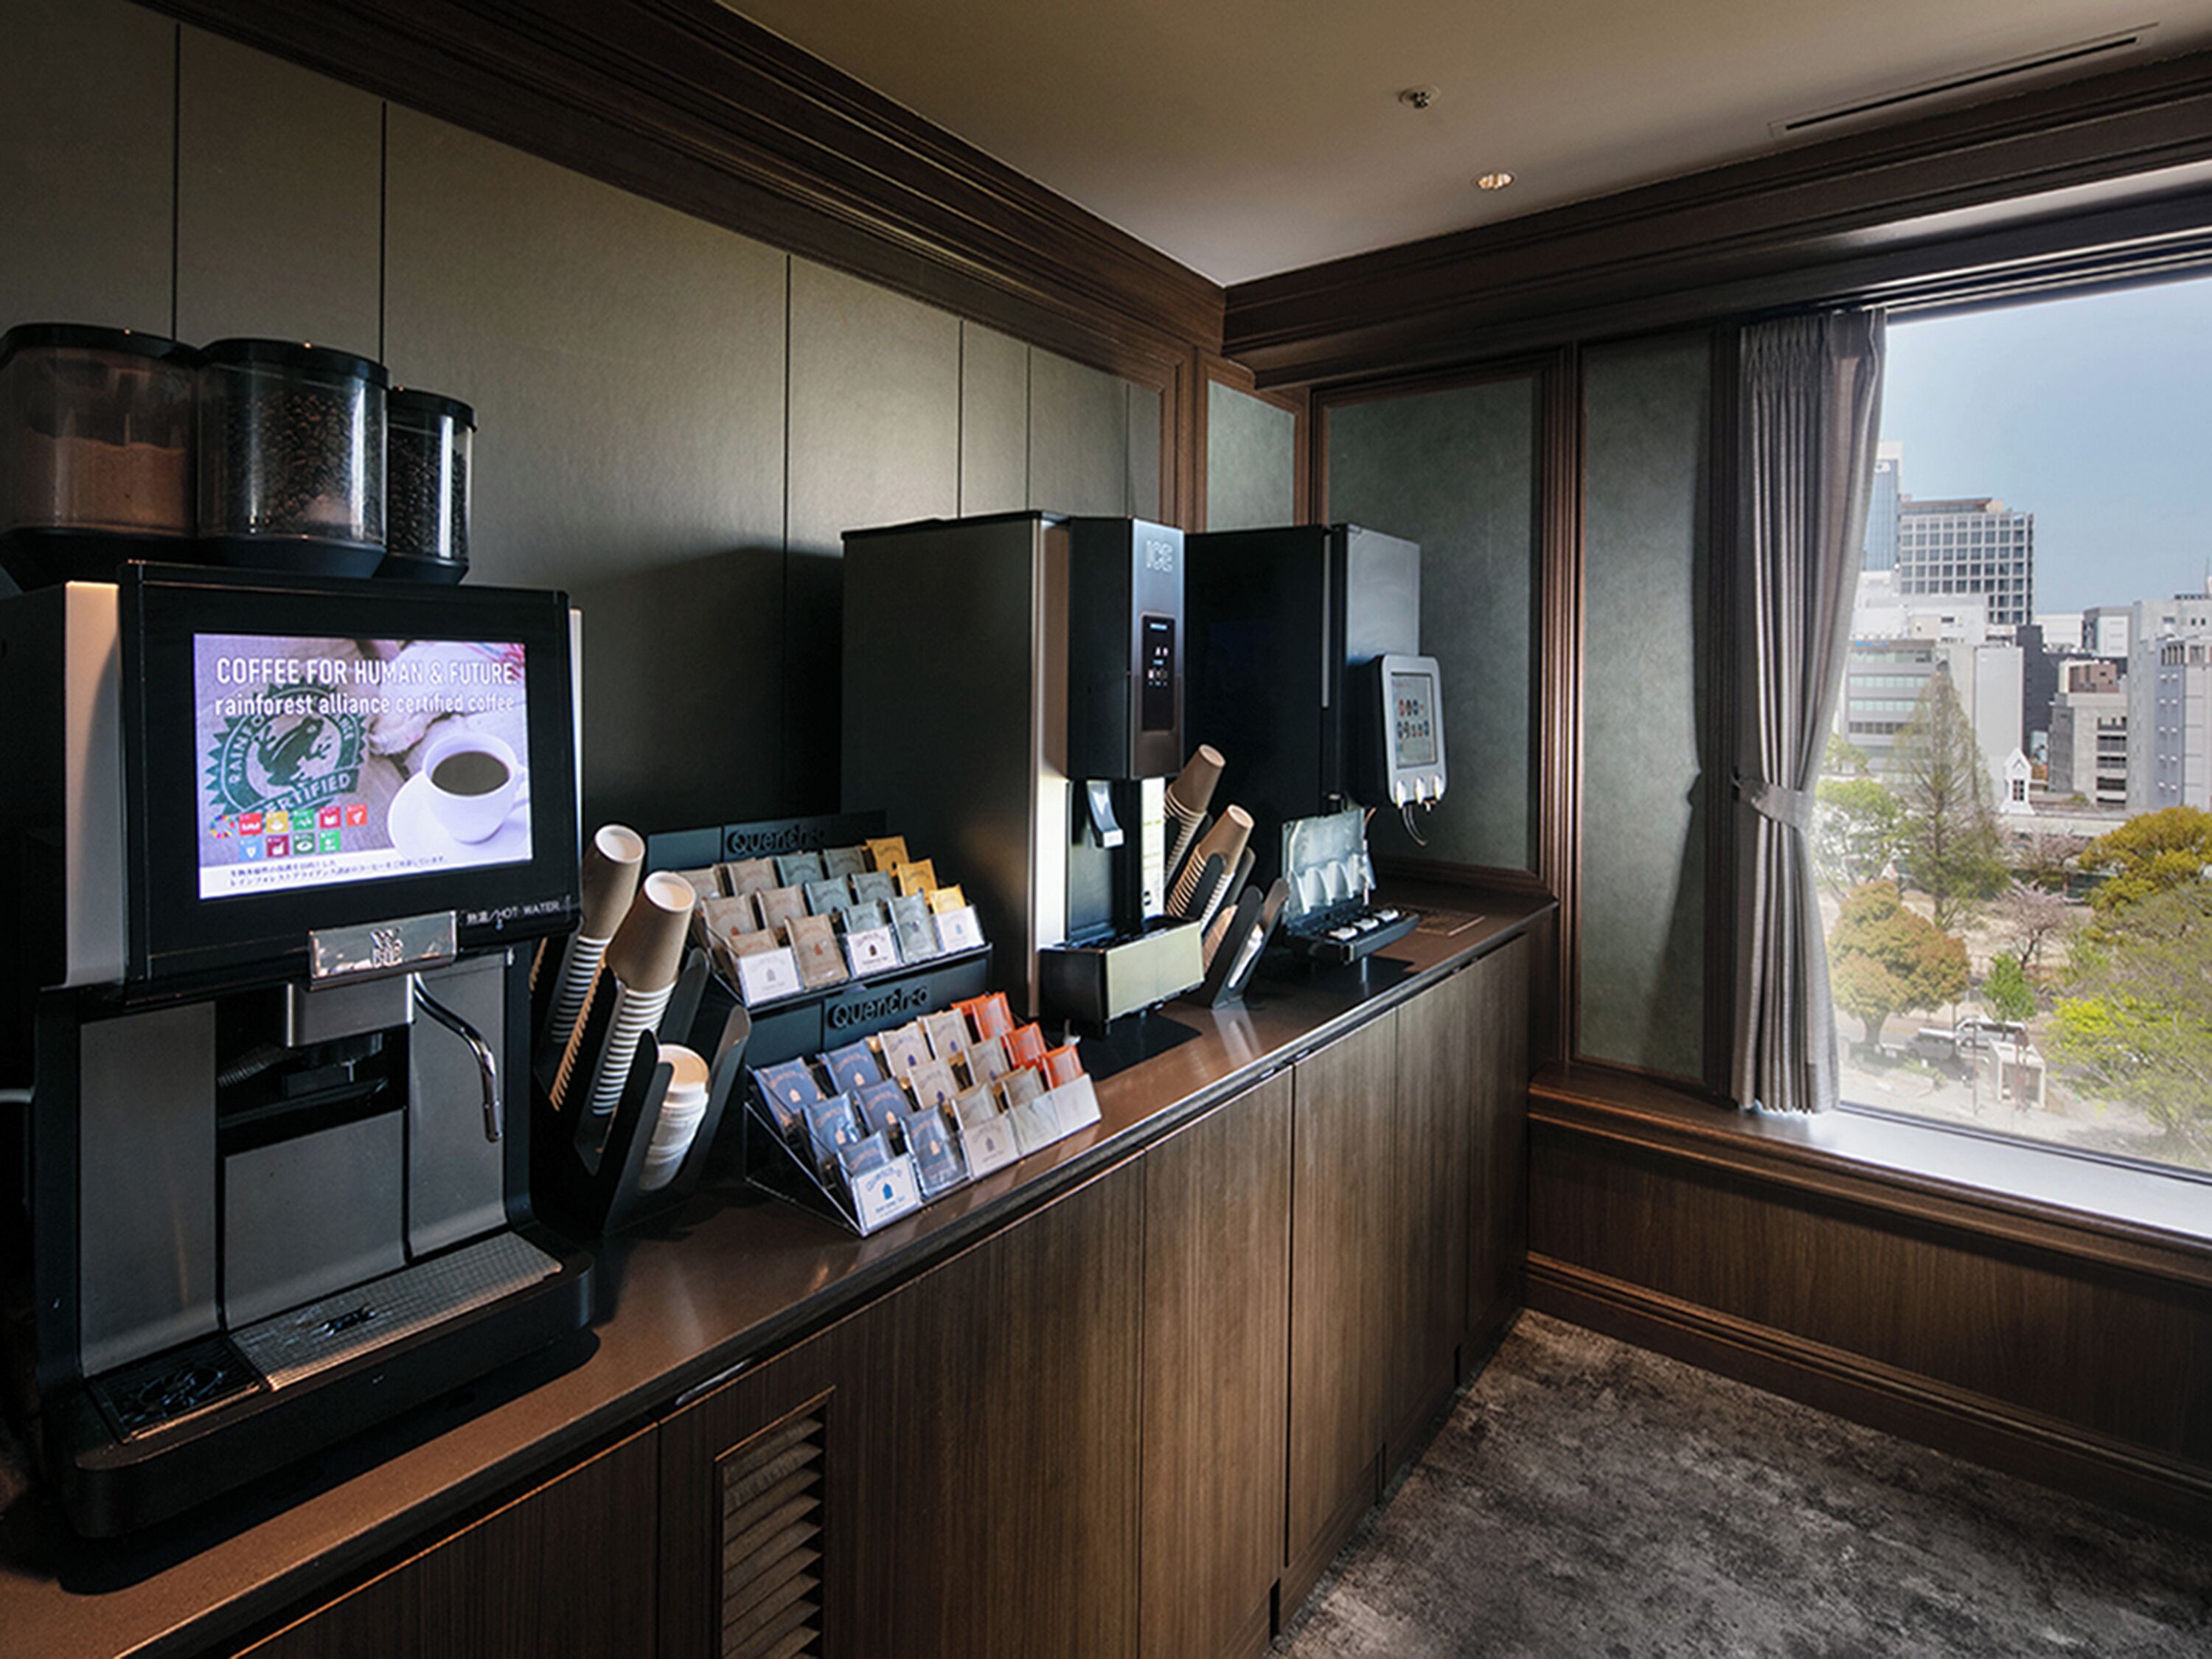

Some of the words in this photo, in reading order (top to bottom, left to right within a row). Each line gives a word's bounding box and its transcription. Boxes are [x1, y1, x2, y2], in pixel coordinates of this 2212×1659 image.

[1146, 539, 1174, 573] ICE
[217, 657, 300, 684] COFFEE
[307, 658, 347, 684] FOR
[355, 660, 422, 684] HUMAN
[430, 661, 442, 684] &
[215, 692, 313, 716] rainforest
[319, 692, 389, 714] alliance
[396, 692, 464, 712] certified
[468, 692, 513, 712] coffee
[255, 773, 351, 812] ERTIFIED
[523, 900, 561, 915] WATER
